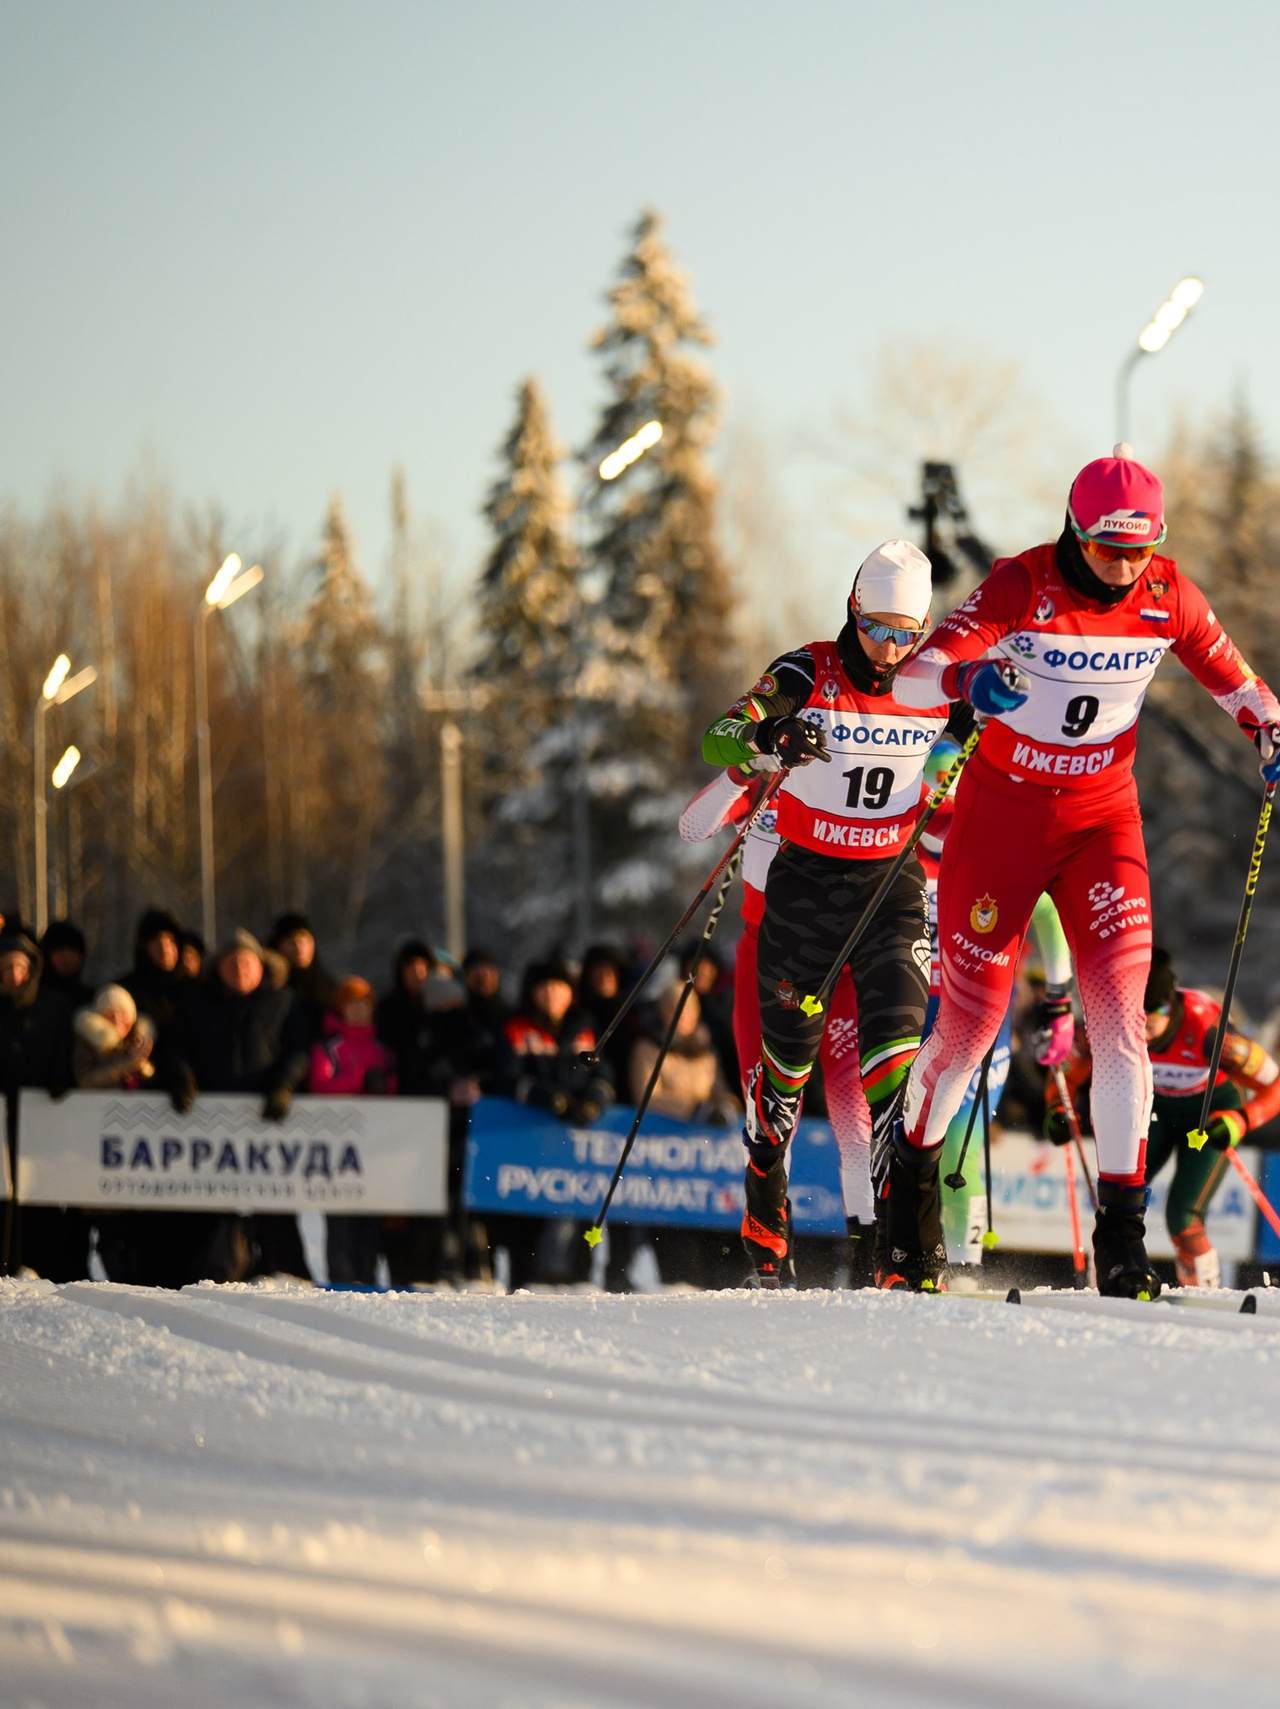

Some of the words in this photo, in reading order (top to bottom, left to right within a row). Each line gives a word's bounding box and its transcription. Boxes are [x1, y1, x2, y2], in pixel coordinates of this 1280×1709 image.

[1103, 519, 1148, 531] ЛУКОЙЛ
[1042, 648, 1163, 671] ФОСАГРО
[1061, 695, 1100, 738] 9
[831, 723, 937, 746] ФОСАГРО
[842, 766, 895, 810] 19
[812, 818, 900, 847] ИЖЕВСК
[1089, 896, 1147, 931] ФОСАГРО
[951, 931, 1011, 967] ЛУКОЙЛ
[101, 1135, 363, 1179] БАРРАКУДА
